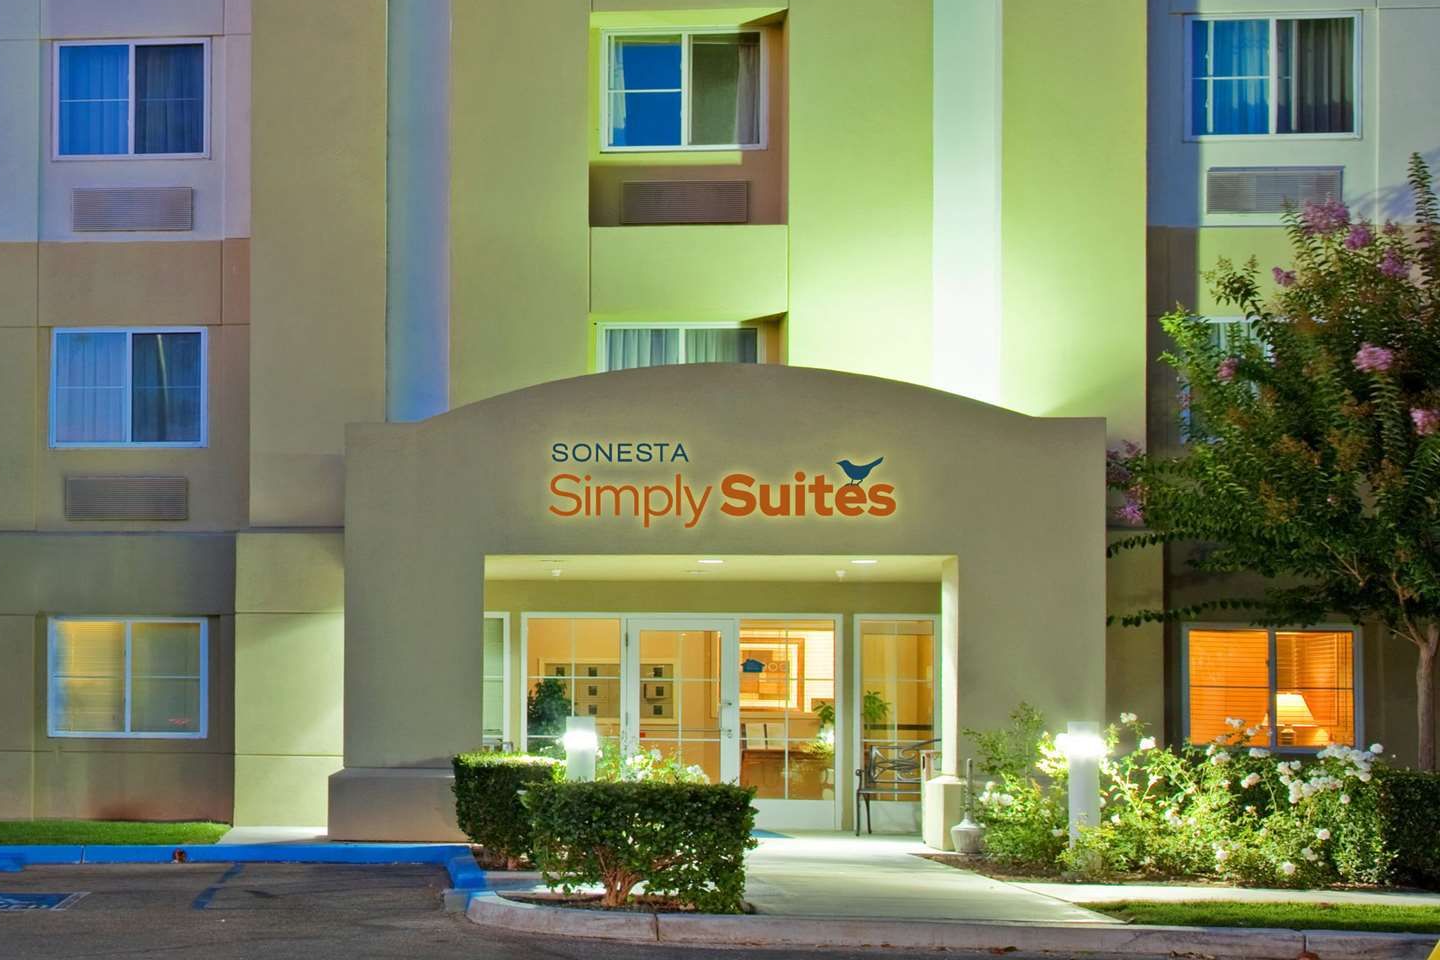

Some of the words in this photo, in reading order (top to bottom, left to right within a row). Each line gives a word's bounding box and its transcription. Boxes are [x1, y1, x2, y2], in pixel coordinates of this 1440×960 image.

[551, 442, 689, 463] SONESTA
[548, 472, 712, 528] Simply
[720, 471, 897, 517] Suites
